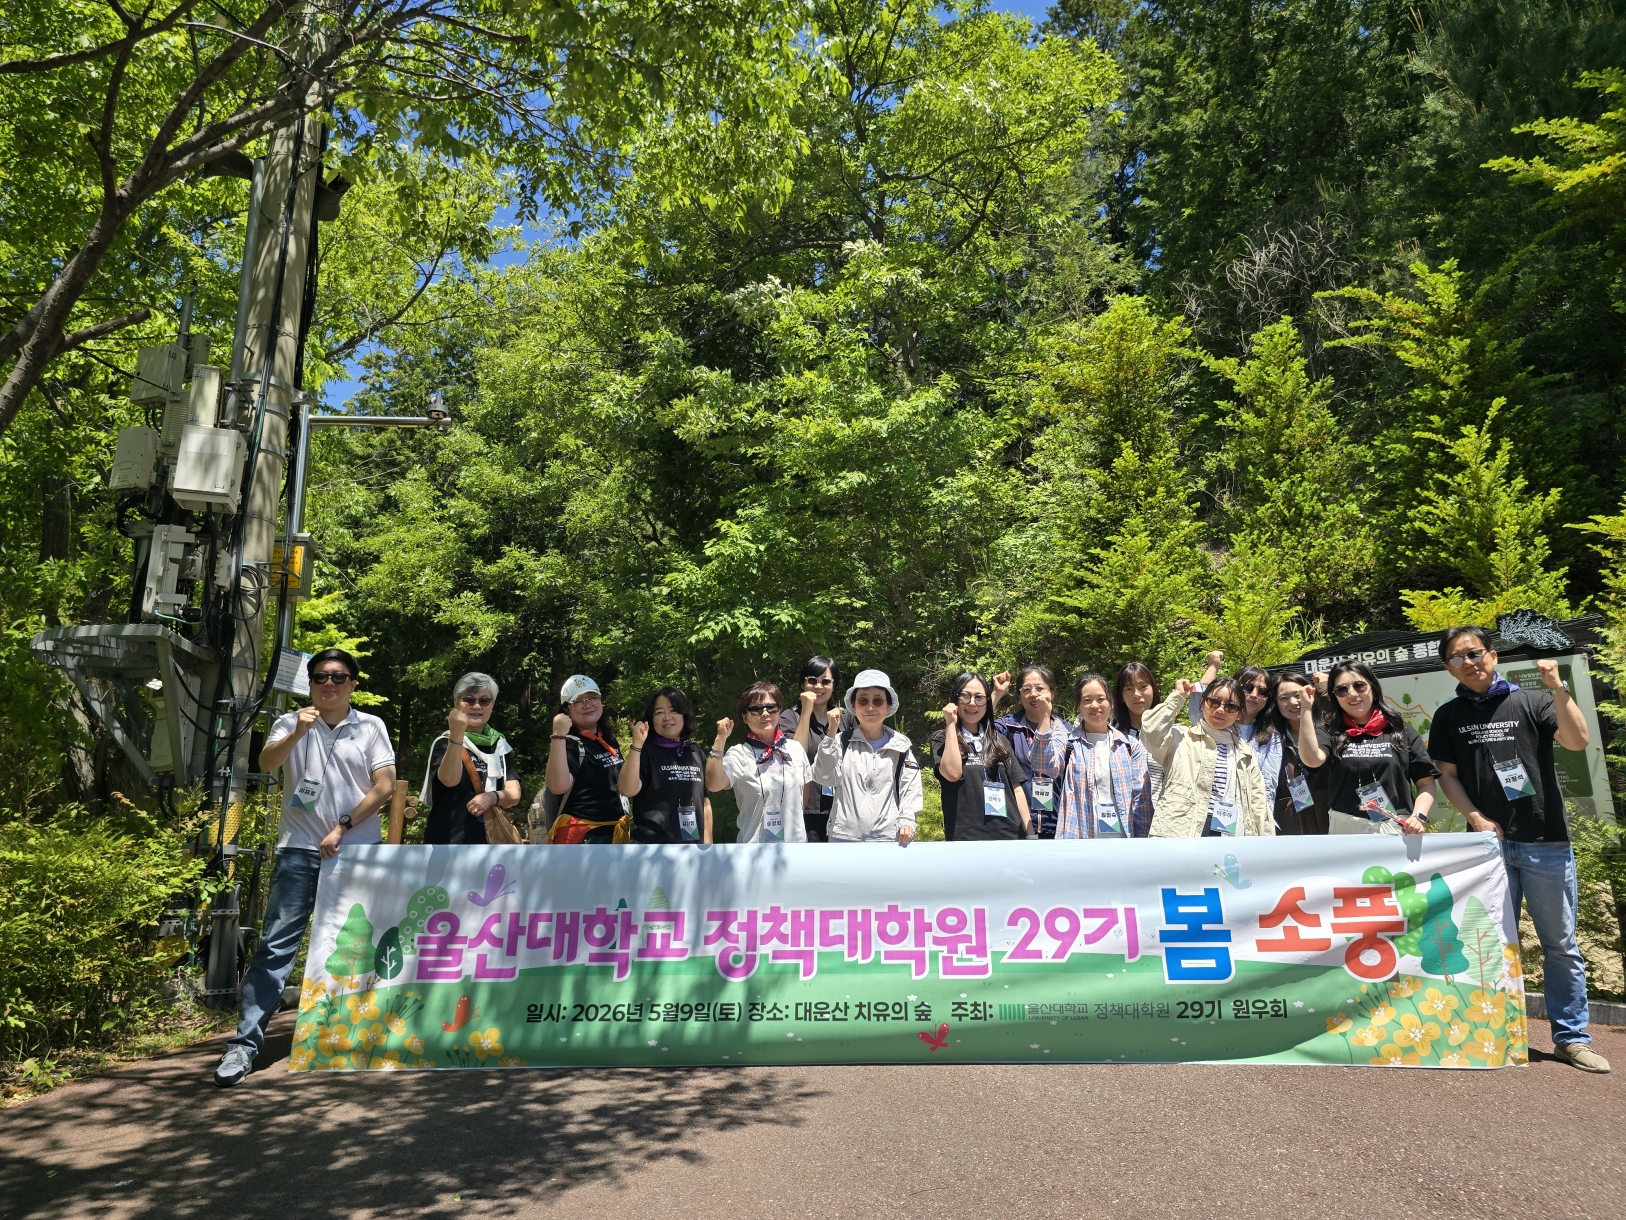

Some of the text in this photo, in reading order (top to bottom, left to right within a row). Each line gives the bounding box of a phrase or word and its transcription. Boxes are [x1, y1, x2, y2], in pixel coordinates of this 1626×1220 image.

[1393, 646, 1409, 662] 숲
[1458, 720, 1520, 734] ULSAN UNIVERSITY
[415, 885, 1406, 981] 울산대학교 정책대학원 29기 봄 소풍
[526, 1001, 994, 1023] 일시: 2026년 5월9일(토) 장소: 대운산 치유의 숲 주최:
[1027, 999, 1289, 1020] 울산대학교 정책대학원 29기 원우회
